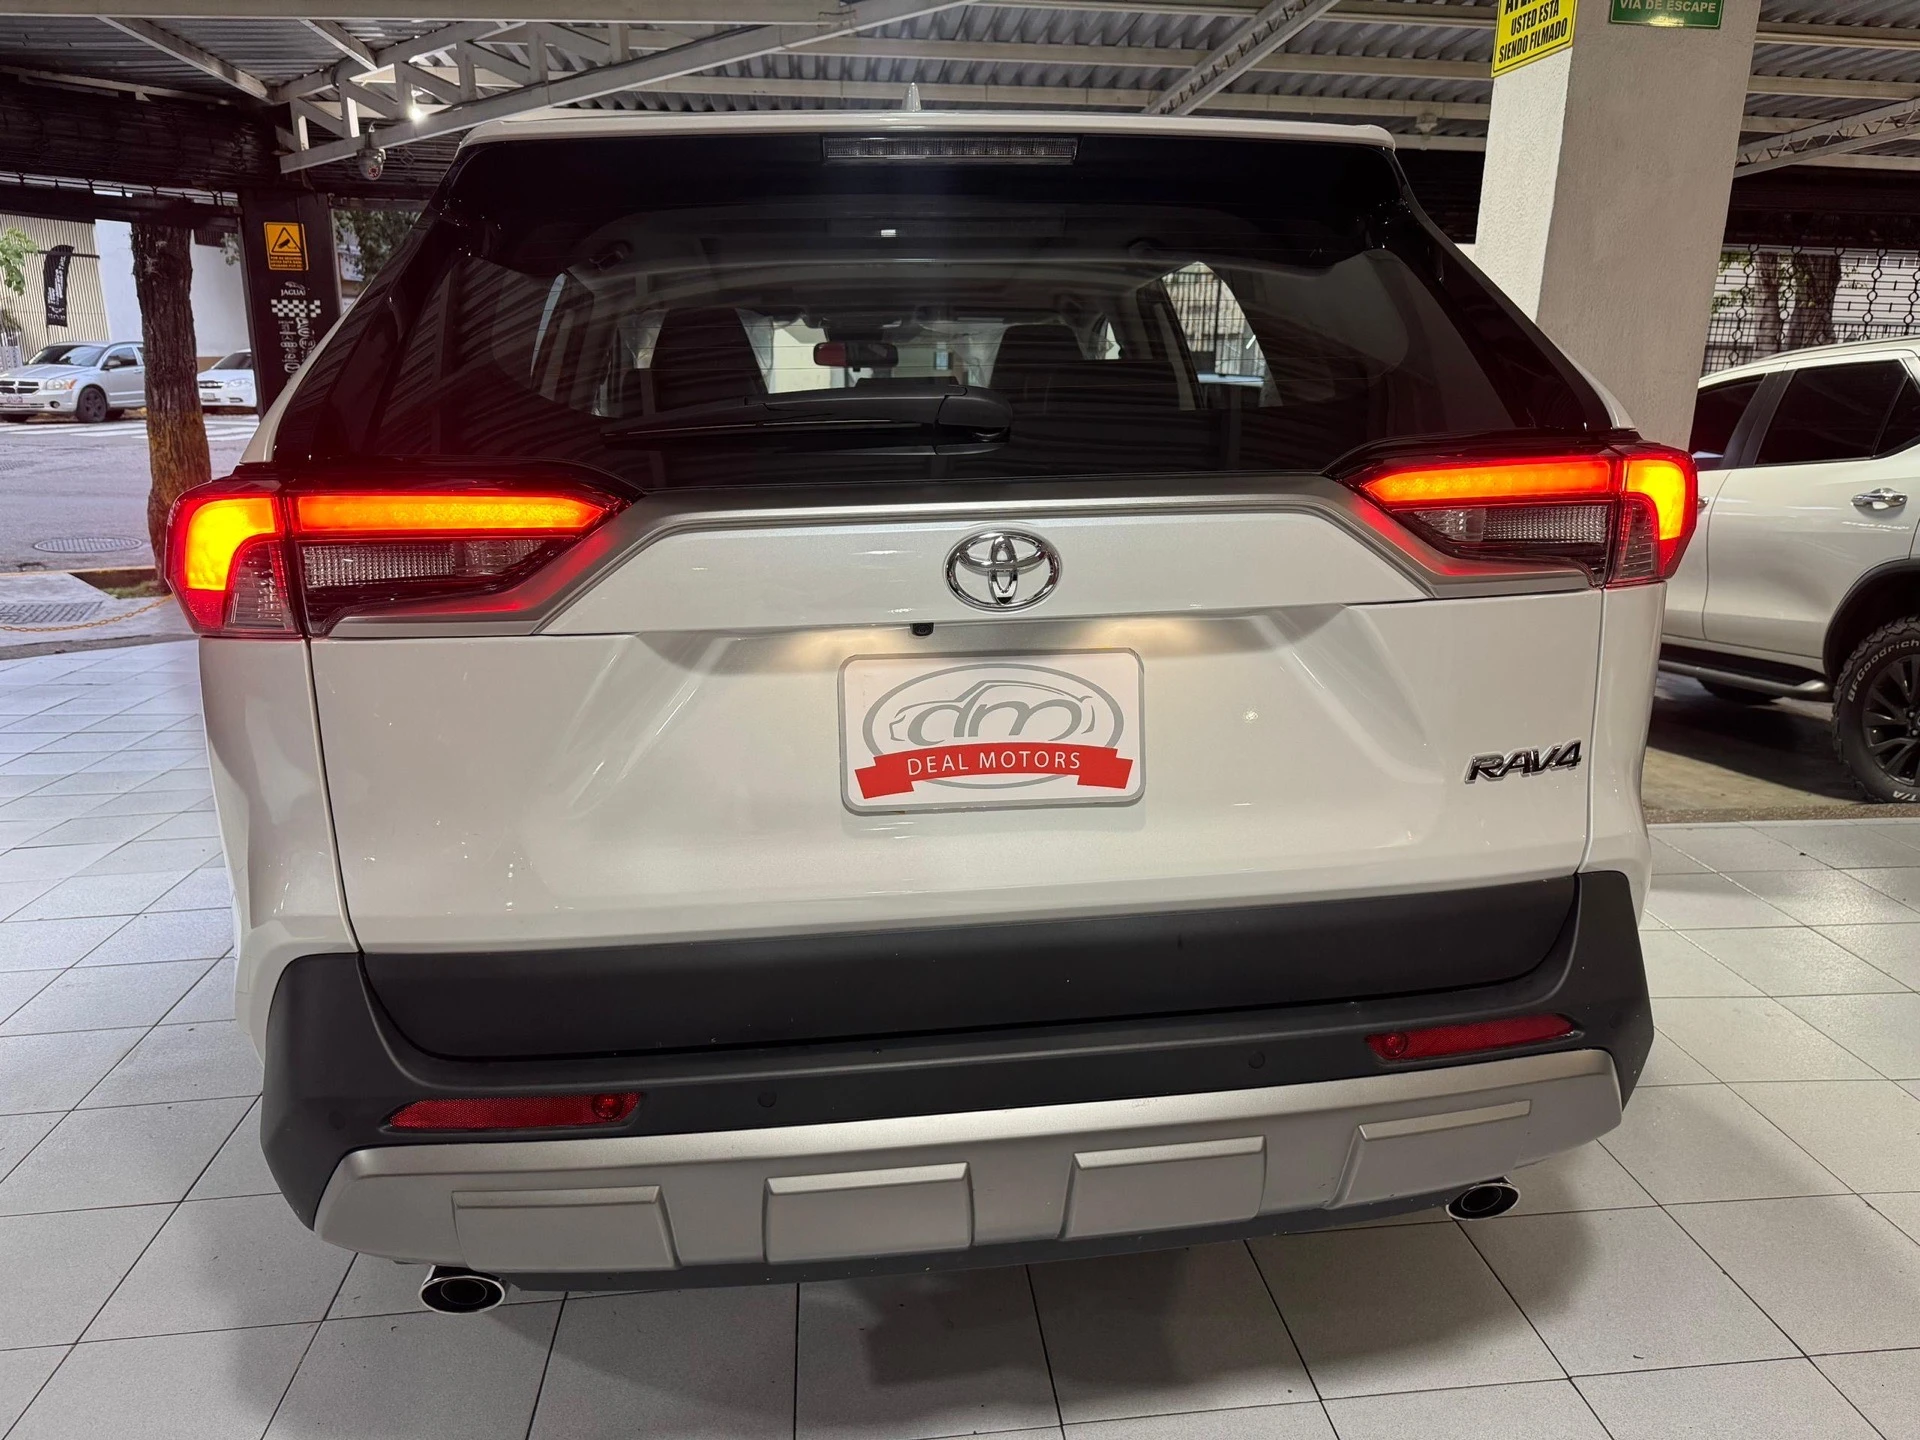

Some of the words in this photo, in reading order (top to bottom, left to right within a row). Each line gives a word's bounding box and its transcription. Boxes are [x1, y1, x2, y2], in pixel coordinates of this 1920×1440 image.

[1510, 8, 1537, 36] USTED
[1538, 0, 1559, 24] ESTA
[1620, 0, 1641, 9] VIA
[1645, 0, 1662, 10] DE
[1666, 0, 1716, 13] ESCAPE
[1499, 35, 1529, 63] SIENDO
[1529, 17, 1568, 51] FILMADO
[1847, 639, 1919, 702] BFGoodrich
[907, 753, 969, 776] DEAL
[979, 750, 1081, 770] MOTORS
[1465, 739, 1582, 784] RAV4
